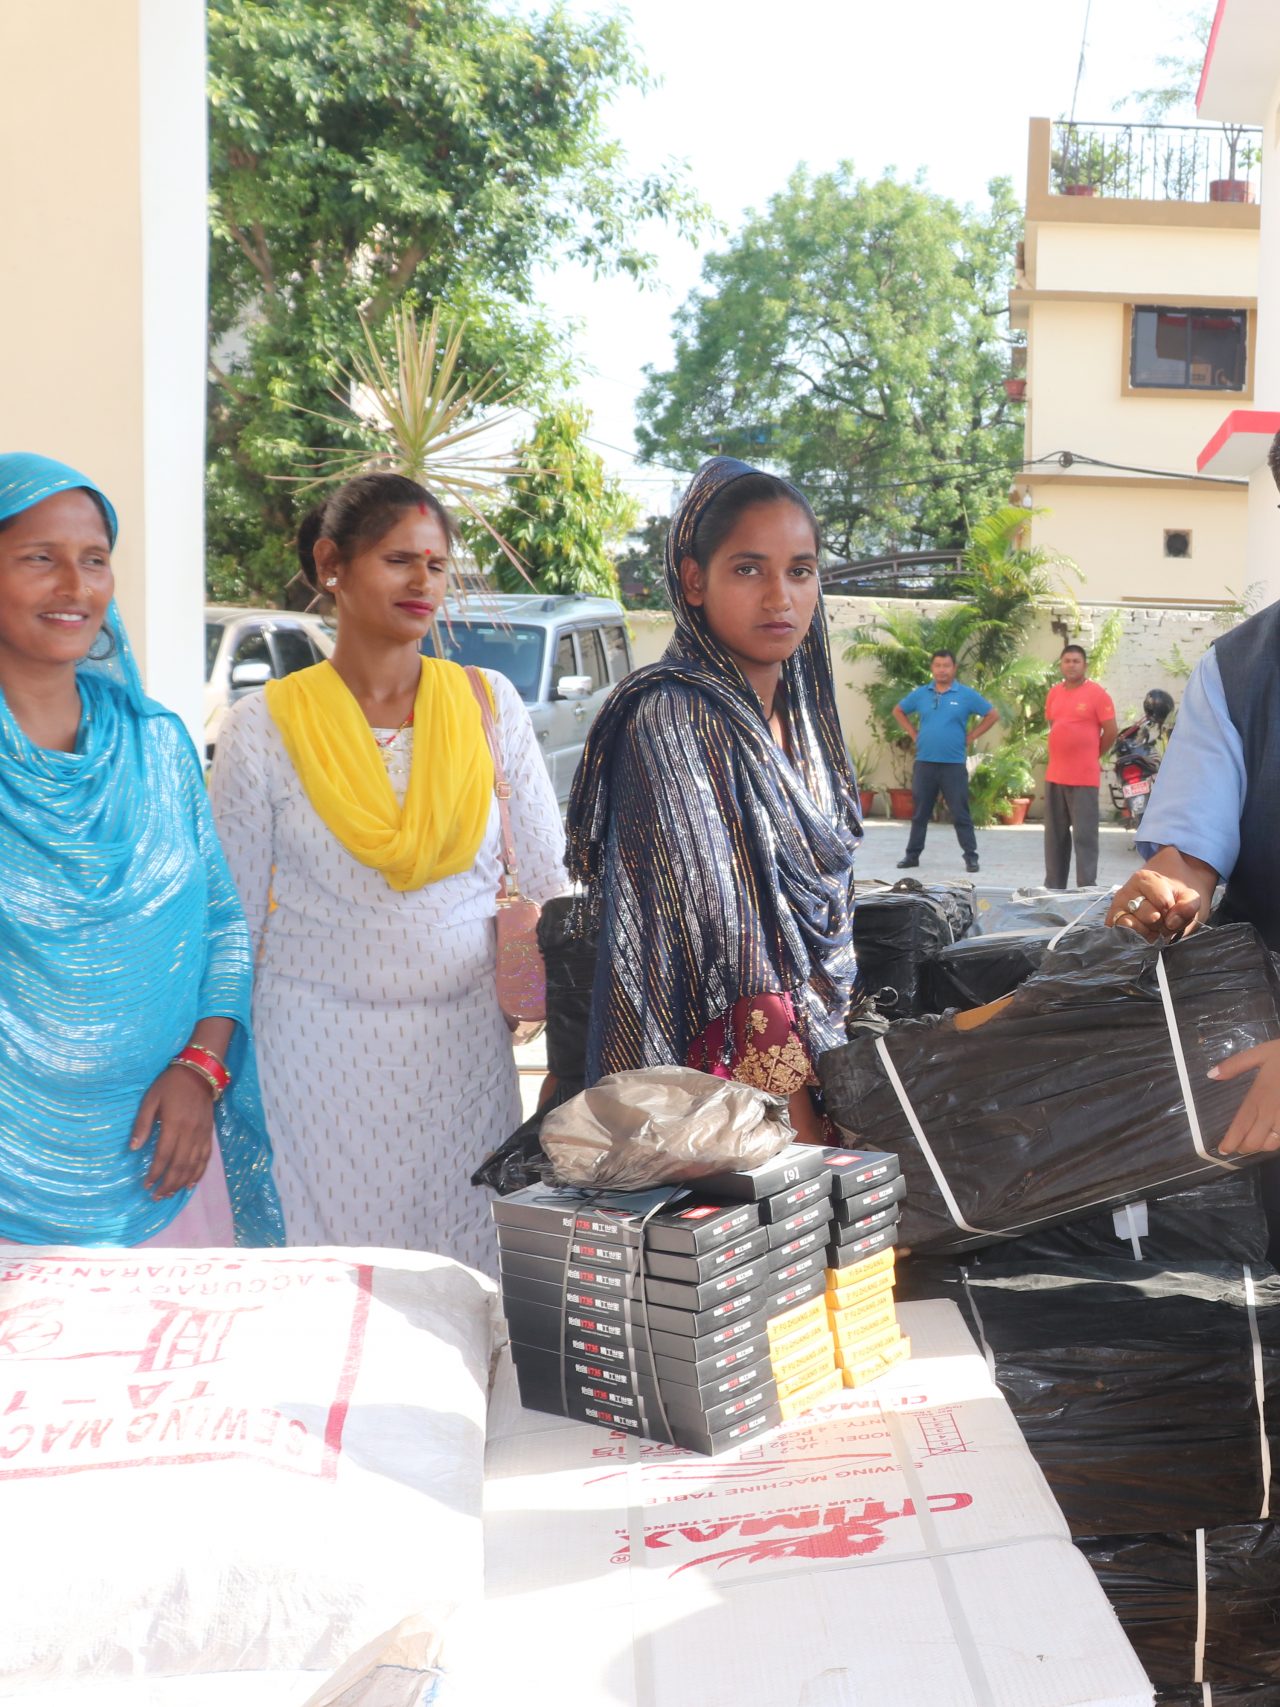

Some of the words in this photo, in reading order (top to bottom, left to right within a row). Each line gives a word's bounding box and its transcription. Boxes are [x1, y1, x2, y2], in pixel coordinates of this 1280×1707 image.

[124, 1405, 309, 1457] SEWING
[724, 1474, 828, 1497] MACHINE
[646, 1491, 718, 1505] TABLE
[827, 1496, 875, 1507] YOUR
[717, 1512, 756, 1522] OUR
[614, 1518, 711, 1536] STRENGH
